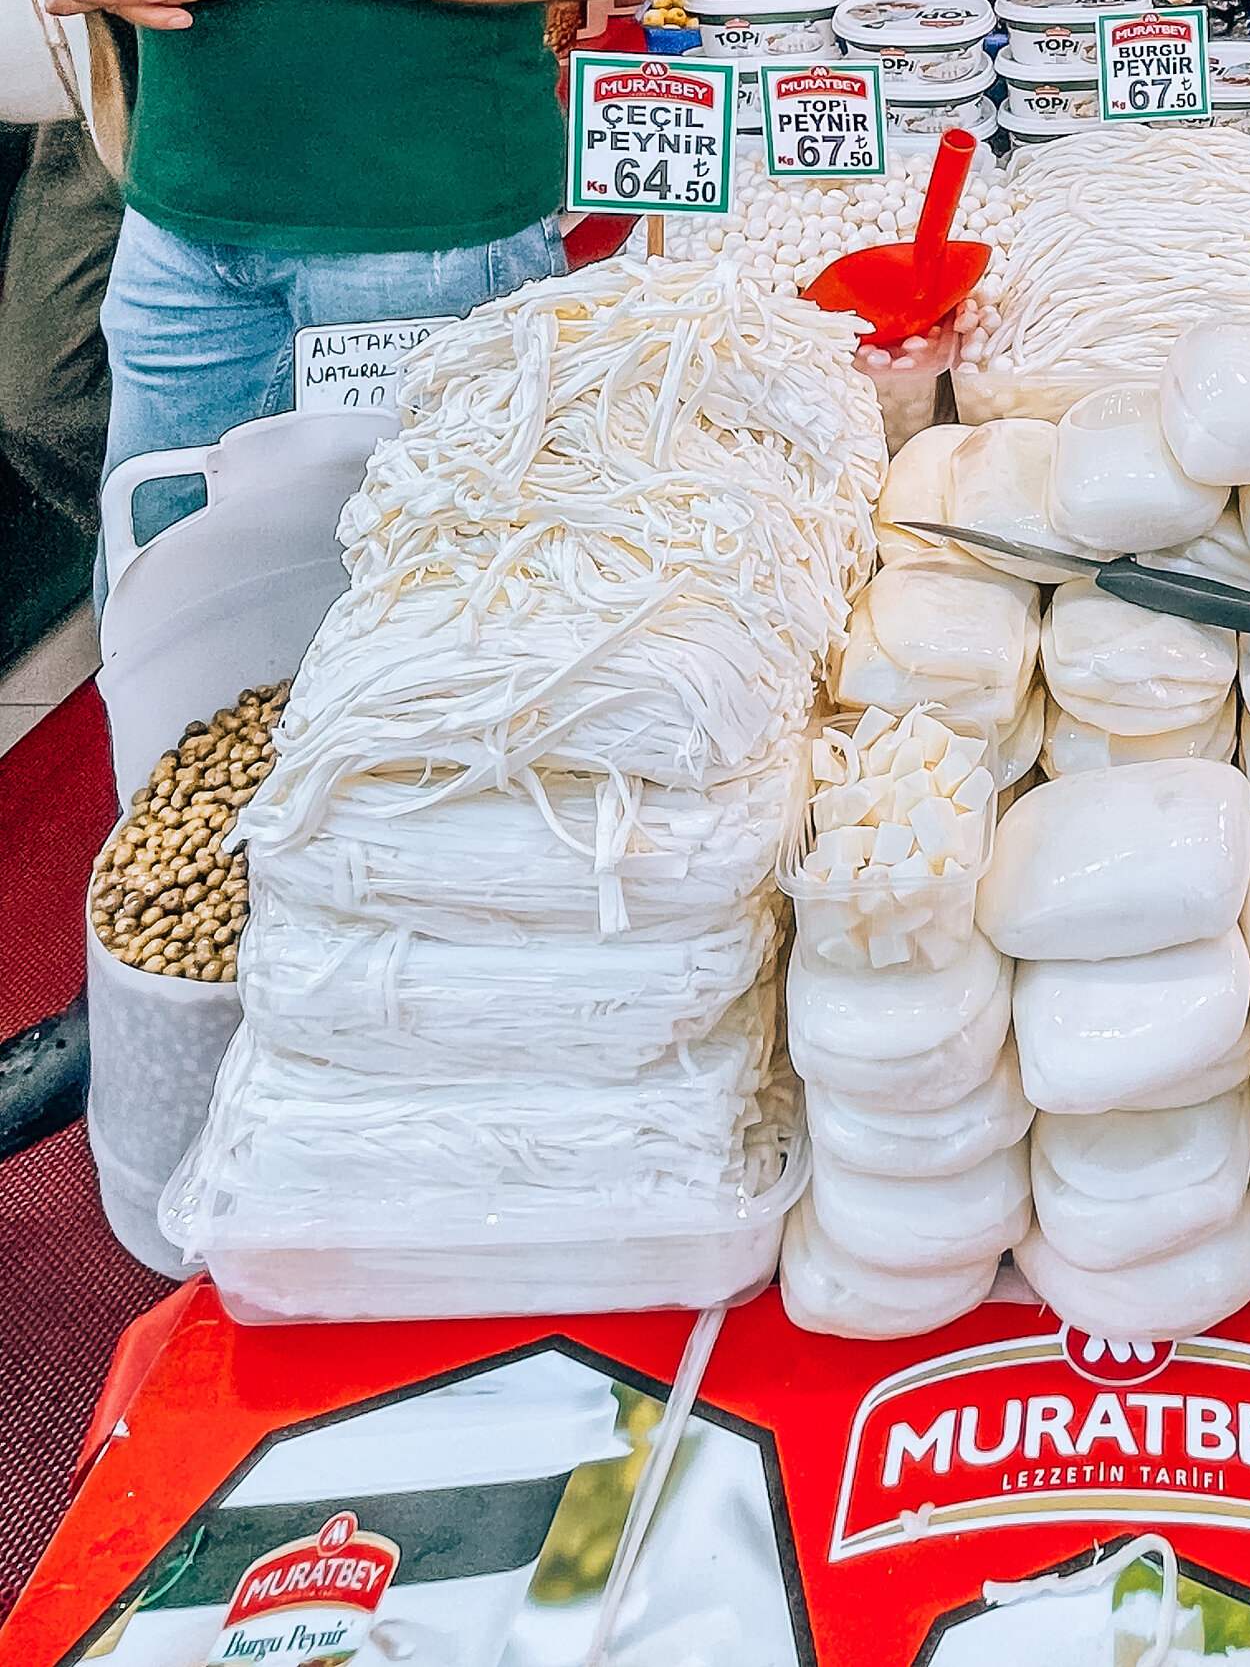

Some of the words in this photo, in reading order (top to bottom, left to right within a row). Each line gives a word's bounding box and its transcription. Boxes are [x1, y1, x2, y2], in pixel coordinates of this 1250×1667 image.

[1116, 25, 1187, 40] MURATBEY
[1119, 43, 1186, 58] BURGU
[600, 79, 709, 100] MURATBEY
[781, 79, 861, 93] MURATBEY
[1112, 100, 1126, 110] Kg
[1129, 78, 1197, 110] 67.50
[778, 155, 794, 166] Kg
[797, 135, 873, 167] 67.50
[587, 180, 608, 195] Kg
[614, 157, 716, 203] 64.50
[306, 363, 397, 387] NATURAL
[1002, 1462, 1124, 1491] LEZZETİN
[1140, 1465, 1225, 1491] TARİFİ
[243, 1556, 386, 1608] MURATBEY
[222, 1629, 282, 1661] Burgu
[288, 1620, 349, 1654] Peynir
